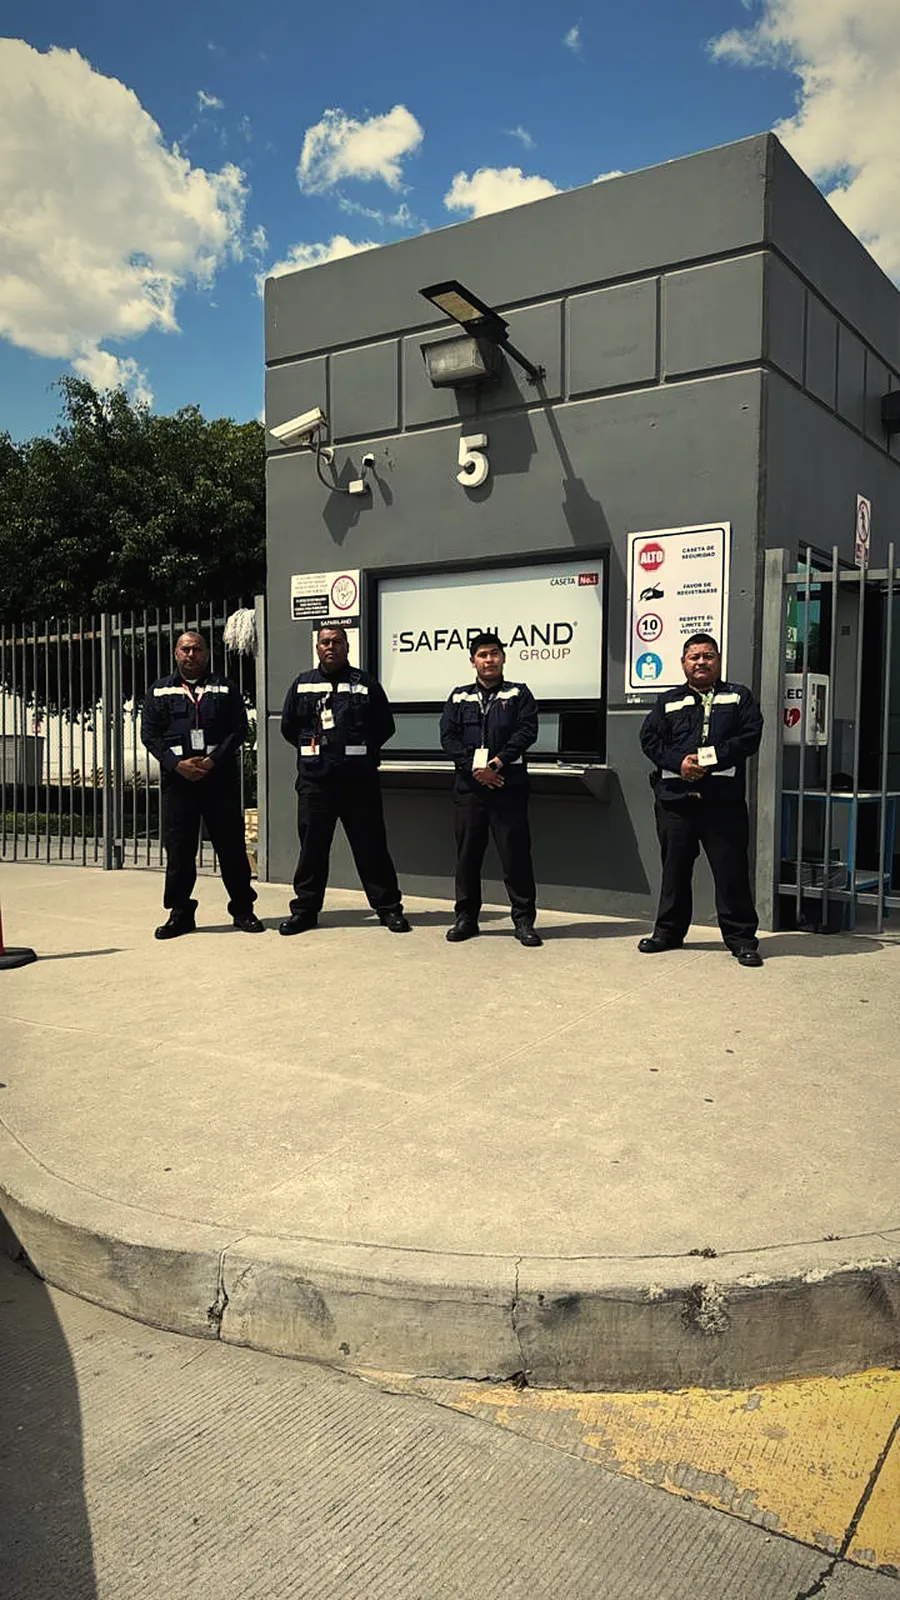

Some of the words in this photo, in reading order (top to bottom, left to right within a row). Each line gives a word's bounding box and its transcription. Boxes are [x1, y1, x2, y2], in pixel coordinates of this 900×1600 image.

[456, 433, 488, 487] 5
[640, 550, 663, 564] ALTO
[682, 552, 716, 560] SEGURIDAD
[550, 577, 576, 586] CASETA
[579, 575, 597, 585] No.1
[677, 588, 717, 596] REGISTRARSE
[642, 619, 658, 631] 10
[519, 648, 571, 661] GROUP
[784, 688, 803, 700] ED
